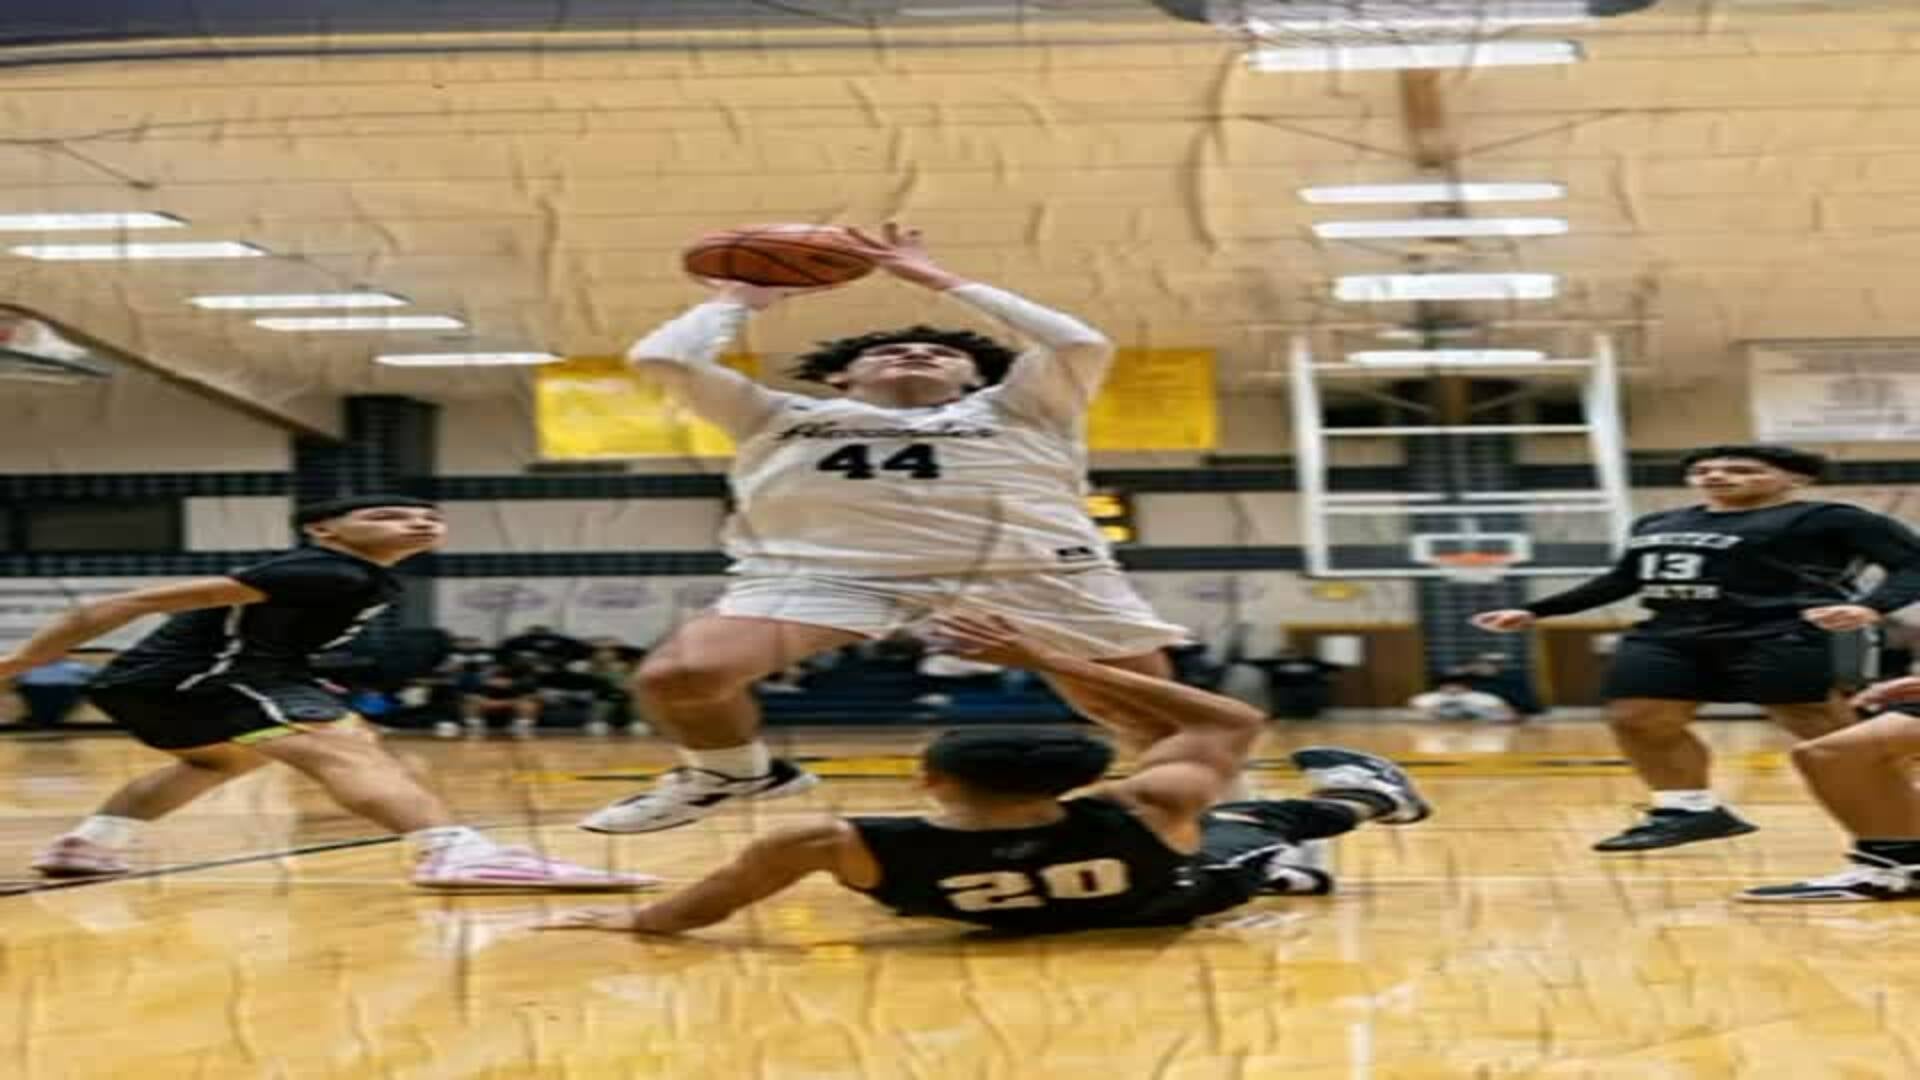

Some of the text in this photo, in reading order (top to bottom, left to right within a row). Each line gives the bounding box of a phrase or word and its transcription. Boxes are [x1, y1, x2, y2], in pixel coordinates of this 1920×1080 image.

[816, 443, 940, 479] 44
[1638, 552, 1705, 580] 13
[937, 858, 1130, 912] 20
